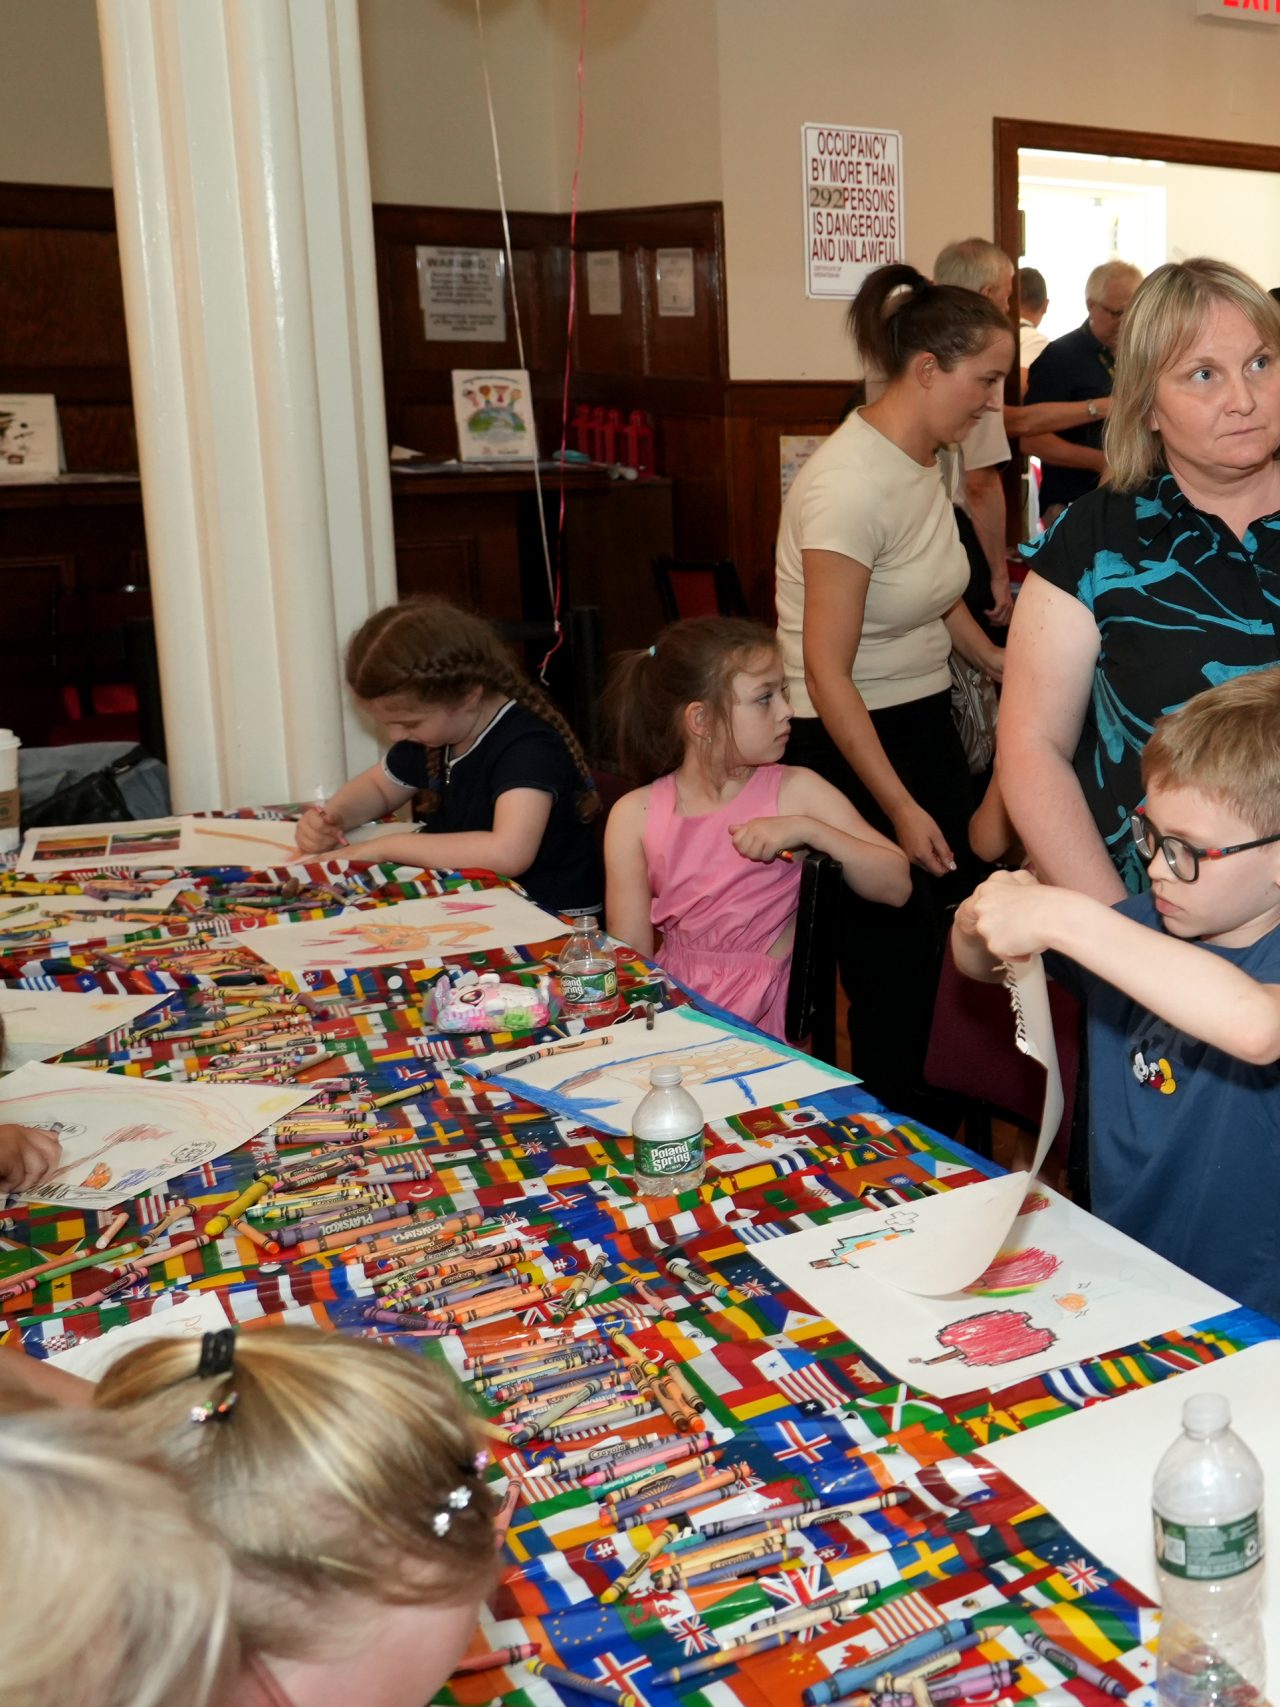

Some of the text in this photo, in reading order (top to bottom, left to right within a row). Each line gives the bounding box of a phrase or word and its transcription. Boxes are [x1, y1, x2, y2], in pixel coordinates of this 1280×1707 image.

[817, 131, 887, 160] OCCUPANCY
[812, 158, 895, 187] BY MORE THAN
[810, 187, 895, 214] 292 PERSONS
[813, 212, 896, 239] IS DANGEROUS
[812, 237, 899, 265] AND UNLAWFUL
[651, 1141, 689, 1161] Poland
[652, 1150, 690, 1172] Spring
[319, 1213, 374, 1237] PLAYSKOOL
[590, 1444, 626, 1460] Crayola
